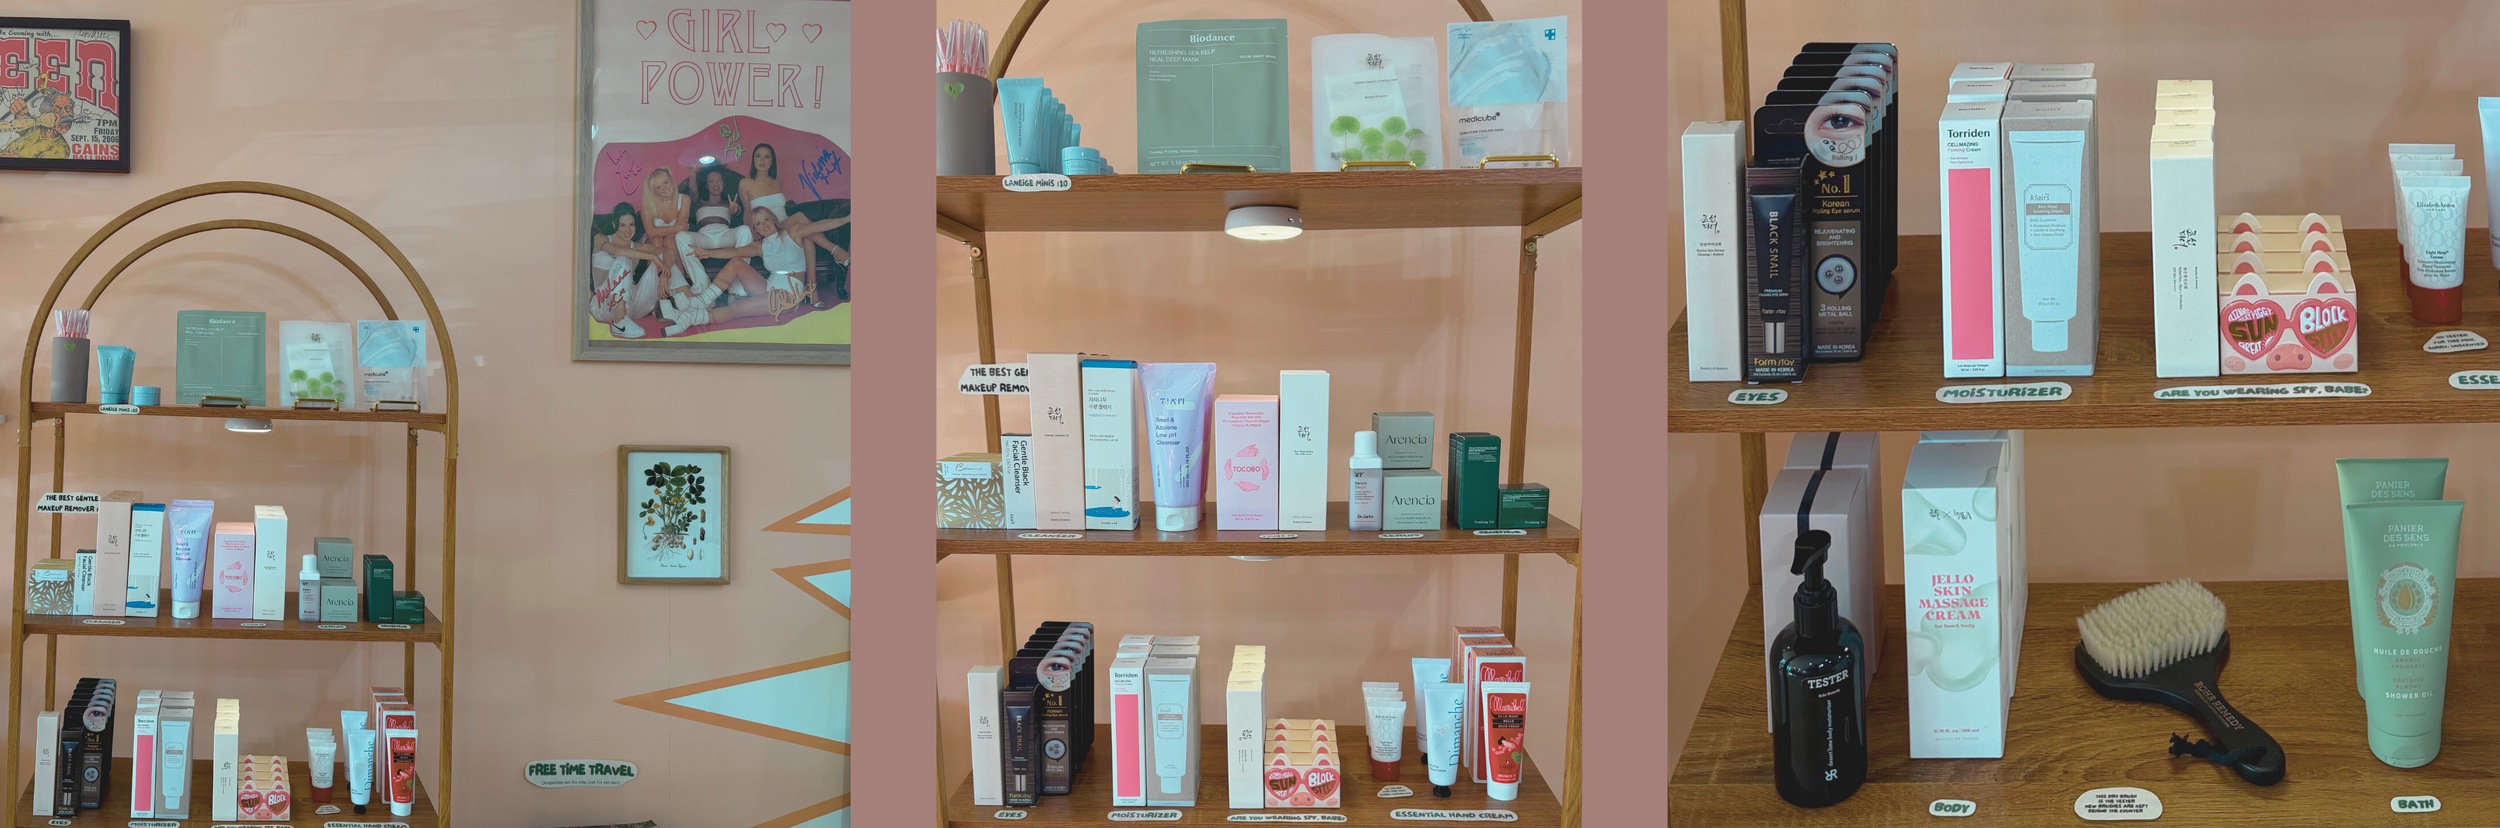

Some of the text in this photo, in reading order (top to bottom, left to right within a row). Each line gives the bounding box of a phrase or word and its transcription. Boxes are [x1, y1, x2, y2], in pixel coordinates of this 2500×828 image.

[8, 29, 35, 39] Evening
[667, 8, 771, 54] GIRL
[1190, 34, 1235, 43] Biodance
[97, 119, 118, 128] 7PM
[1459, 114, 1497, 124] medicube
[94, 127, 119, 136] FRIDAY
[1947, 129, 1990, 138] Torriden
[71, 134, 90, 143] SEPT.
[103, 135, 120, 143] 2006
[71, 143, 120, 155] CAINS
[1004, 179, 1055, 187] LANEIGE MINIS
[1769, 211, 1779, 279] BLACK SNAIL
[2300, 305, 2349, 335] BLOCK
[2229, 314, 2279, 342] SUN
[1753, 358, 1795, 366] Farm stay
[970, 368, 987, 376] THE
[989, 367, 1011, 376] BEST
[960, 383, 997, 392] MAKEUP
[1943, 386, 2063, 398] MOISTURIZER
[2161, 385, 2369, 397] ARE YOU WEARING SPF, BABE?
[1735, 393, 1781, 401] EYES
[1386, 434, 1427, 444] Arencia
[1012, 462, 1021, 494] Cleanser
[1022, 466, 1030, 486] Black
[2376, 481, 2411, 489] PANIER
[46, 494, 99, 502] THE BEST GENTLE
[2371, 490, 2416, 498] DES SENS
[1392, 495, 1435, 505] Arencia
[2388, 525, 2424, 533] PANIER
[2383, 533, 2430, 543] DES SENS
[1931, 574, 1974, 587] JELLO
[1934, 586, 1972, 596] SKIN
[326, 598, 354, 606] Arencia
[1919, 598, 1989, 609] MASSAGE
[1925, 610, 1981, 621] CREAM
[2373, 647, 2397, 655] HUILE
[2413, 645, 2443, 655] DOUCHE
[1807, 669, 1849, 689] TESTER
[2194, 681, 2217, 702] ROHR
[2212, 700, 2245, 730] REMEDY
[1448, 698, 1464, 767] Dimanche
[363, 740, 376, 791] Dimanche
[529, 762, 635, 777] FREE TIME TRAVEL
[1269, 776, 1297, 791] SUN
[1308, 772, 1335, 787] BLOCK
[268, 794, 287, 806] BLOCK
[2398, 799, 2434, 810] BATH
[1934, 802, 1970, 813] BODY
[1111, 811, 1178, 819] MOISTURIZER
